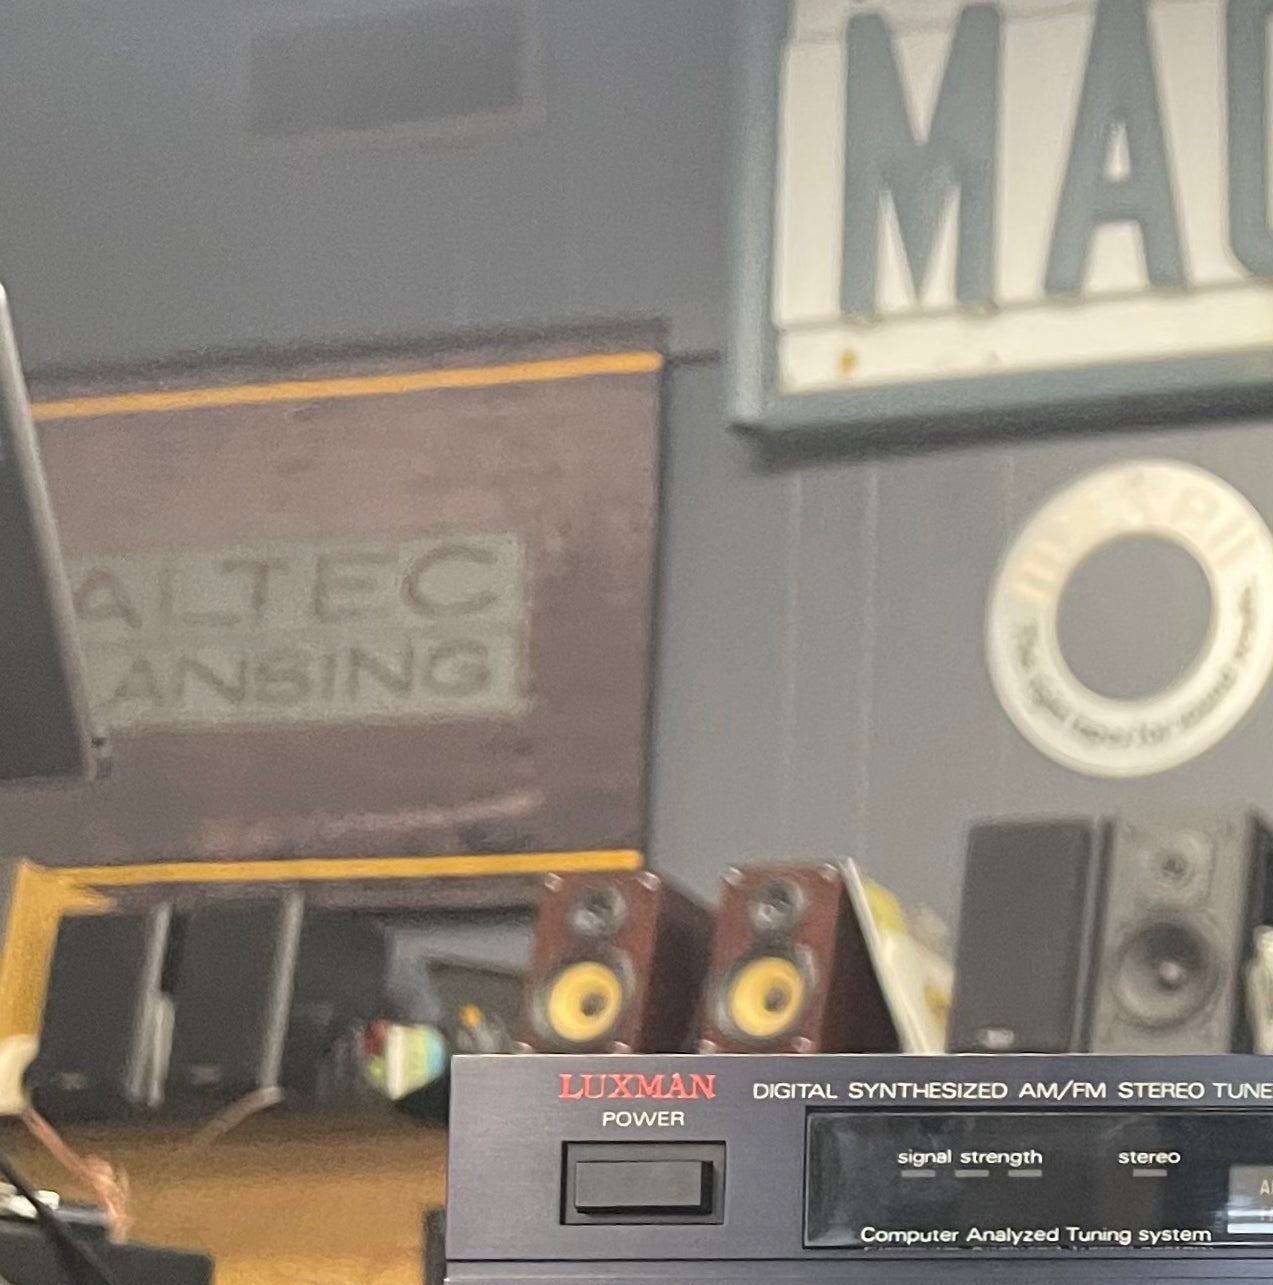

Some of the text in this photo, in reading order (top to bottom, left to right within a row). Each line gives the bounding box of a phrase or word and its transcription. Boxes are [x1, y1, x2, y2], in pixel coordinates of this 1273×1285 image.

[70, 541, 500, 630] ALTEC
[112, 638, 493, 704] ANSING
[558, 1073, 715, 1099] LUXMAN
[753, 1083, 837, 1099] DIGITAL
[849, 1082, 1008, 1098] SYNTHESIZED
[1019, 1080, 1106, 1100] AM/FM
[1118, 1082, 1204, 1099] STEREO
[603, 1112, 684, 1126] POWER
[898, 1149, 1042, 1167] signal strength
[1119, 1152, 1180, 1163] stereo
[861, 1227, 1215, 1245] Computer Analyzed Tuning system
